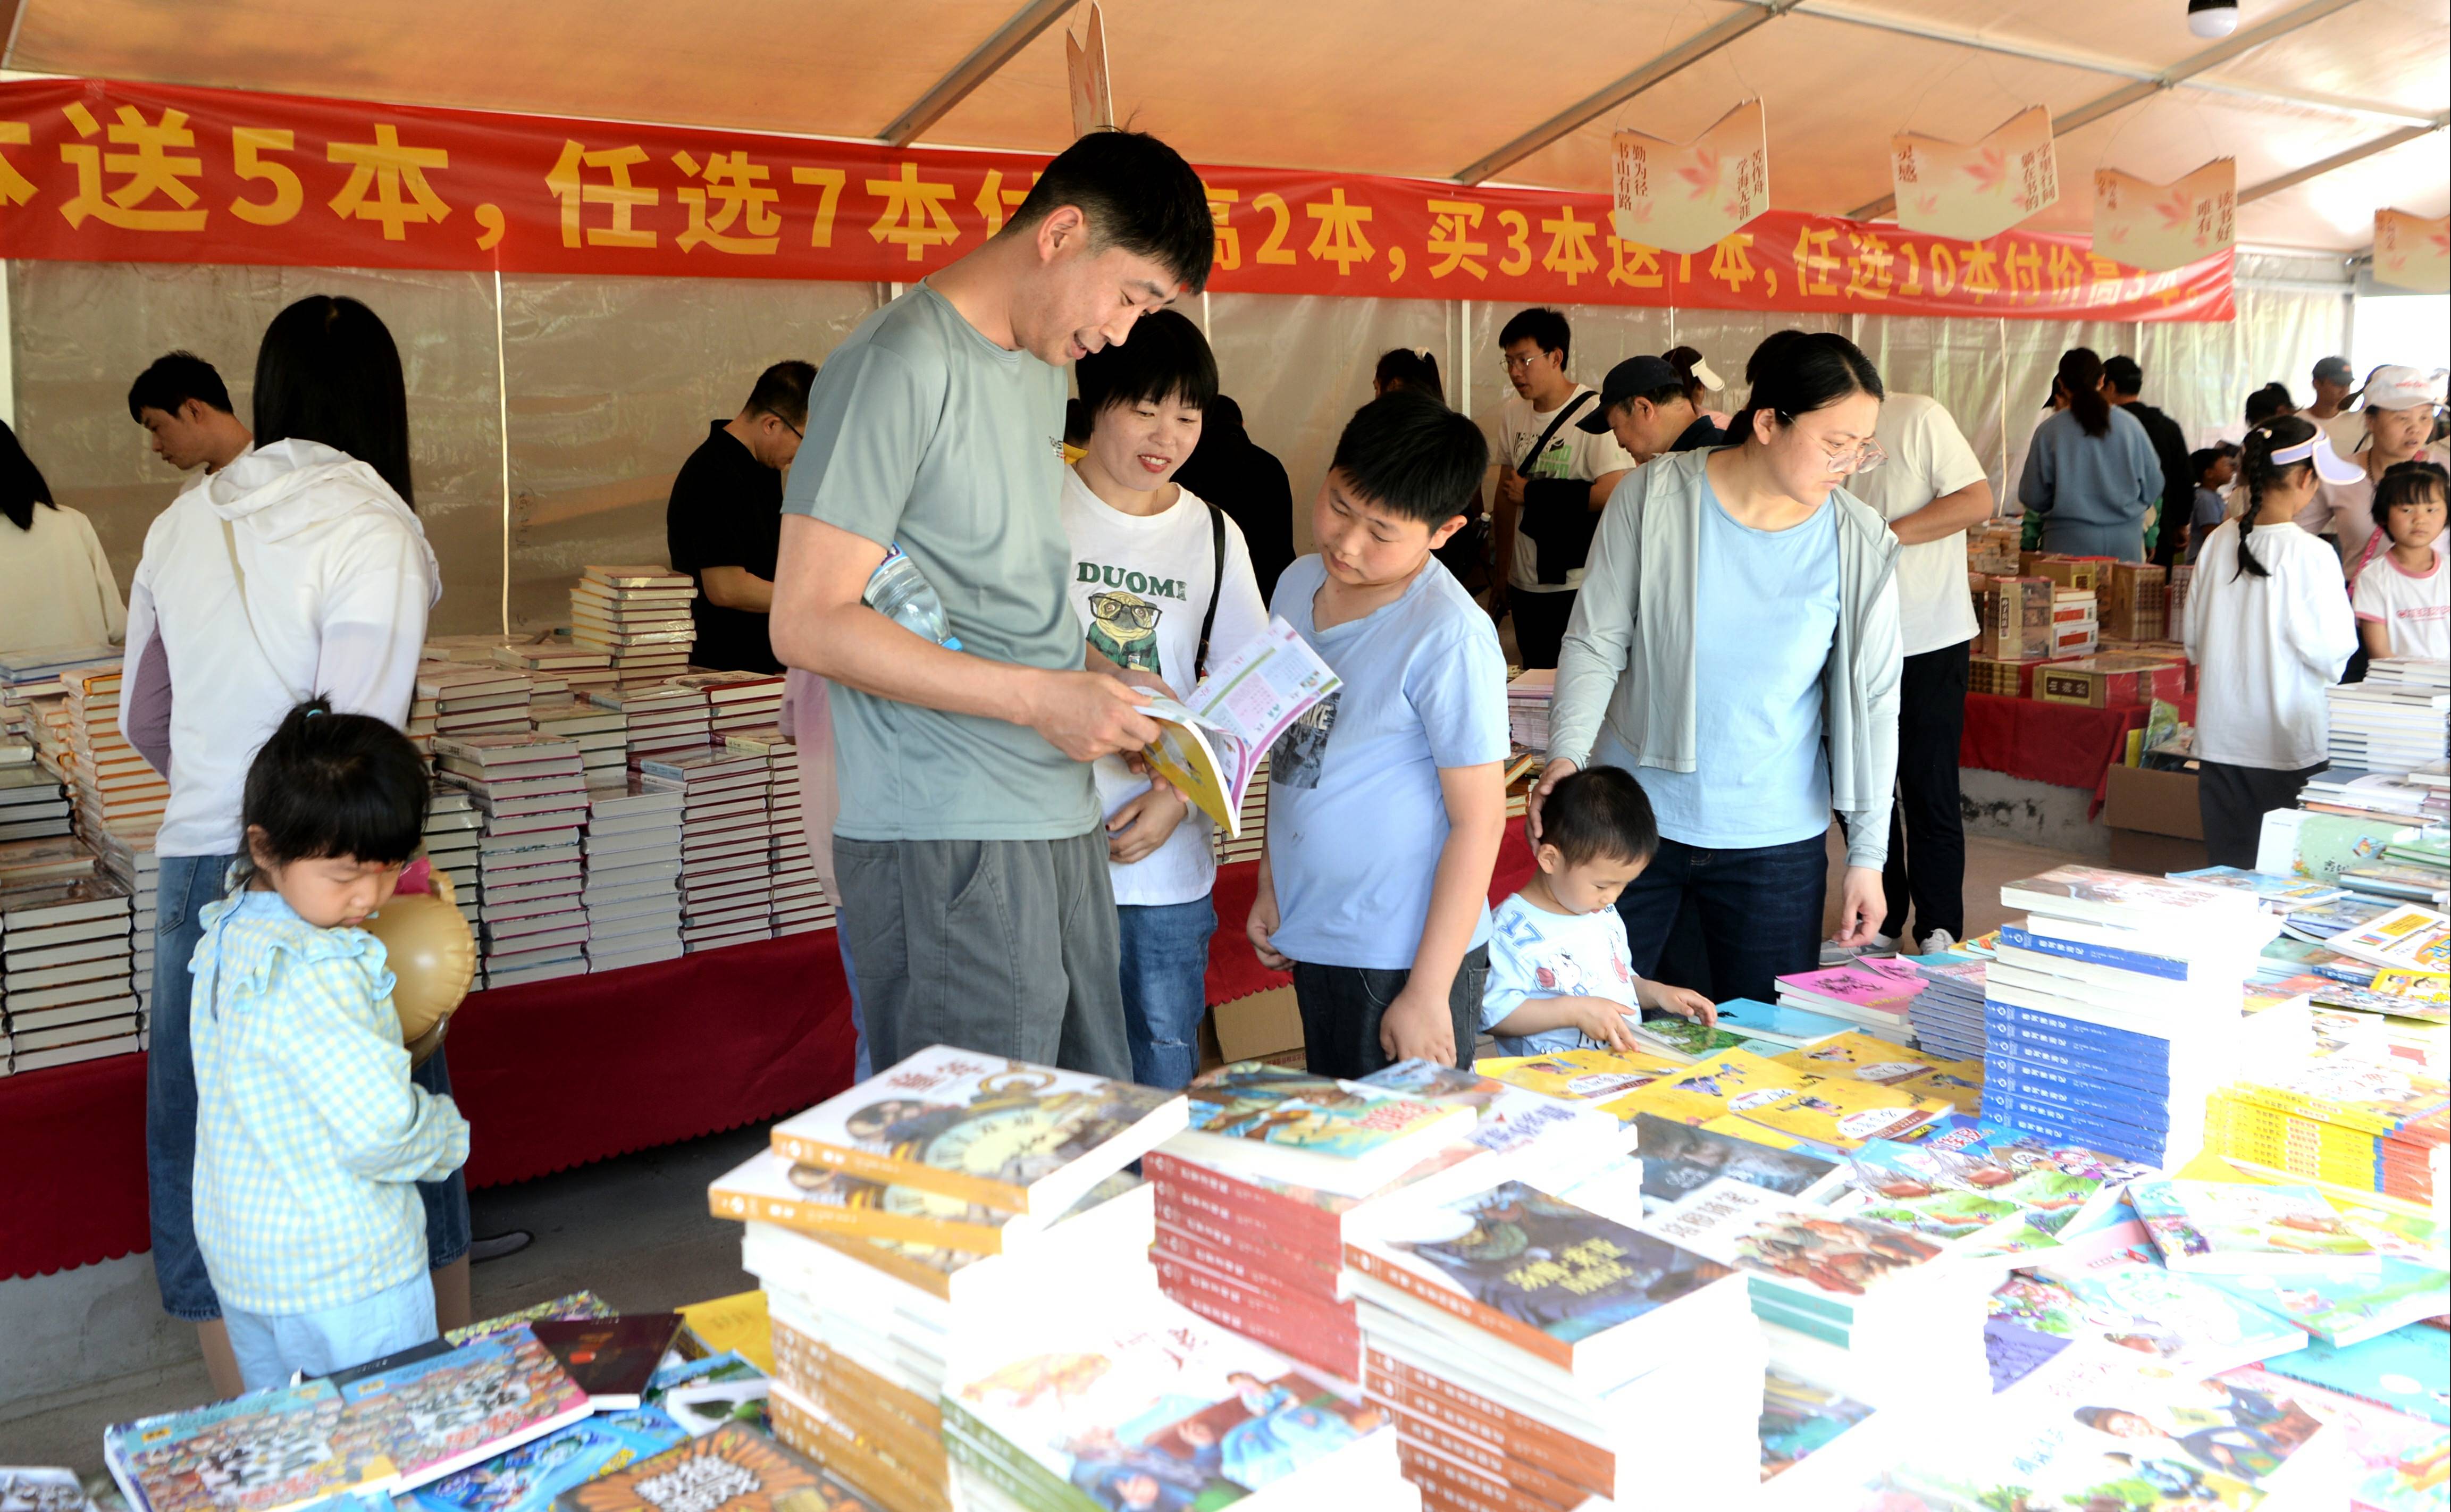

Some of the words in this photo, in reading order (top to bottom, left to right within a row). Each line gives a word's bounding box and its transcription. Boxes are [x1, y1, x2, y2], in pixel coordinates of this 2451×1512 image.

[1617, 142, 1632, 212] 书山有路
[1632, 144, 1648, 197] 勤为径
[1736, 158, 1751, 221] 学海无涯
[1077, 561, 1187, 601] DUOMI
[1498, 910, 1545, 949] 17
